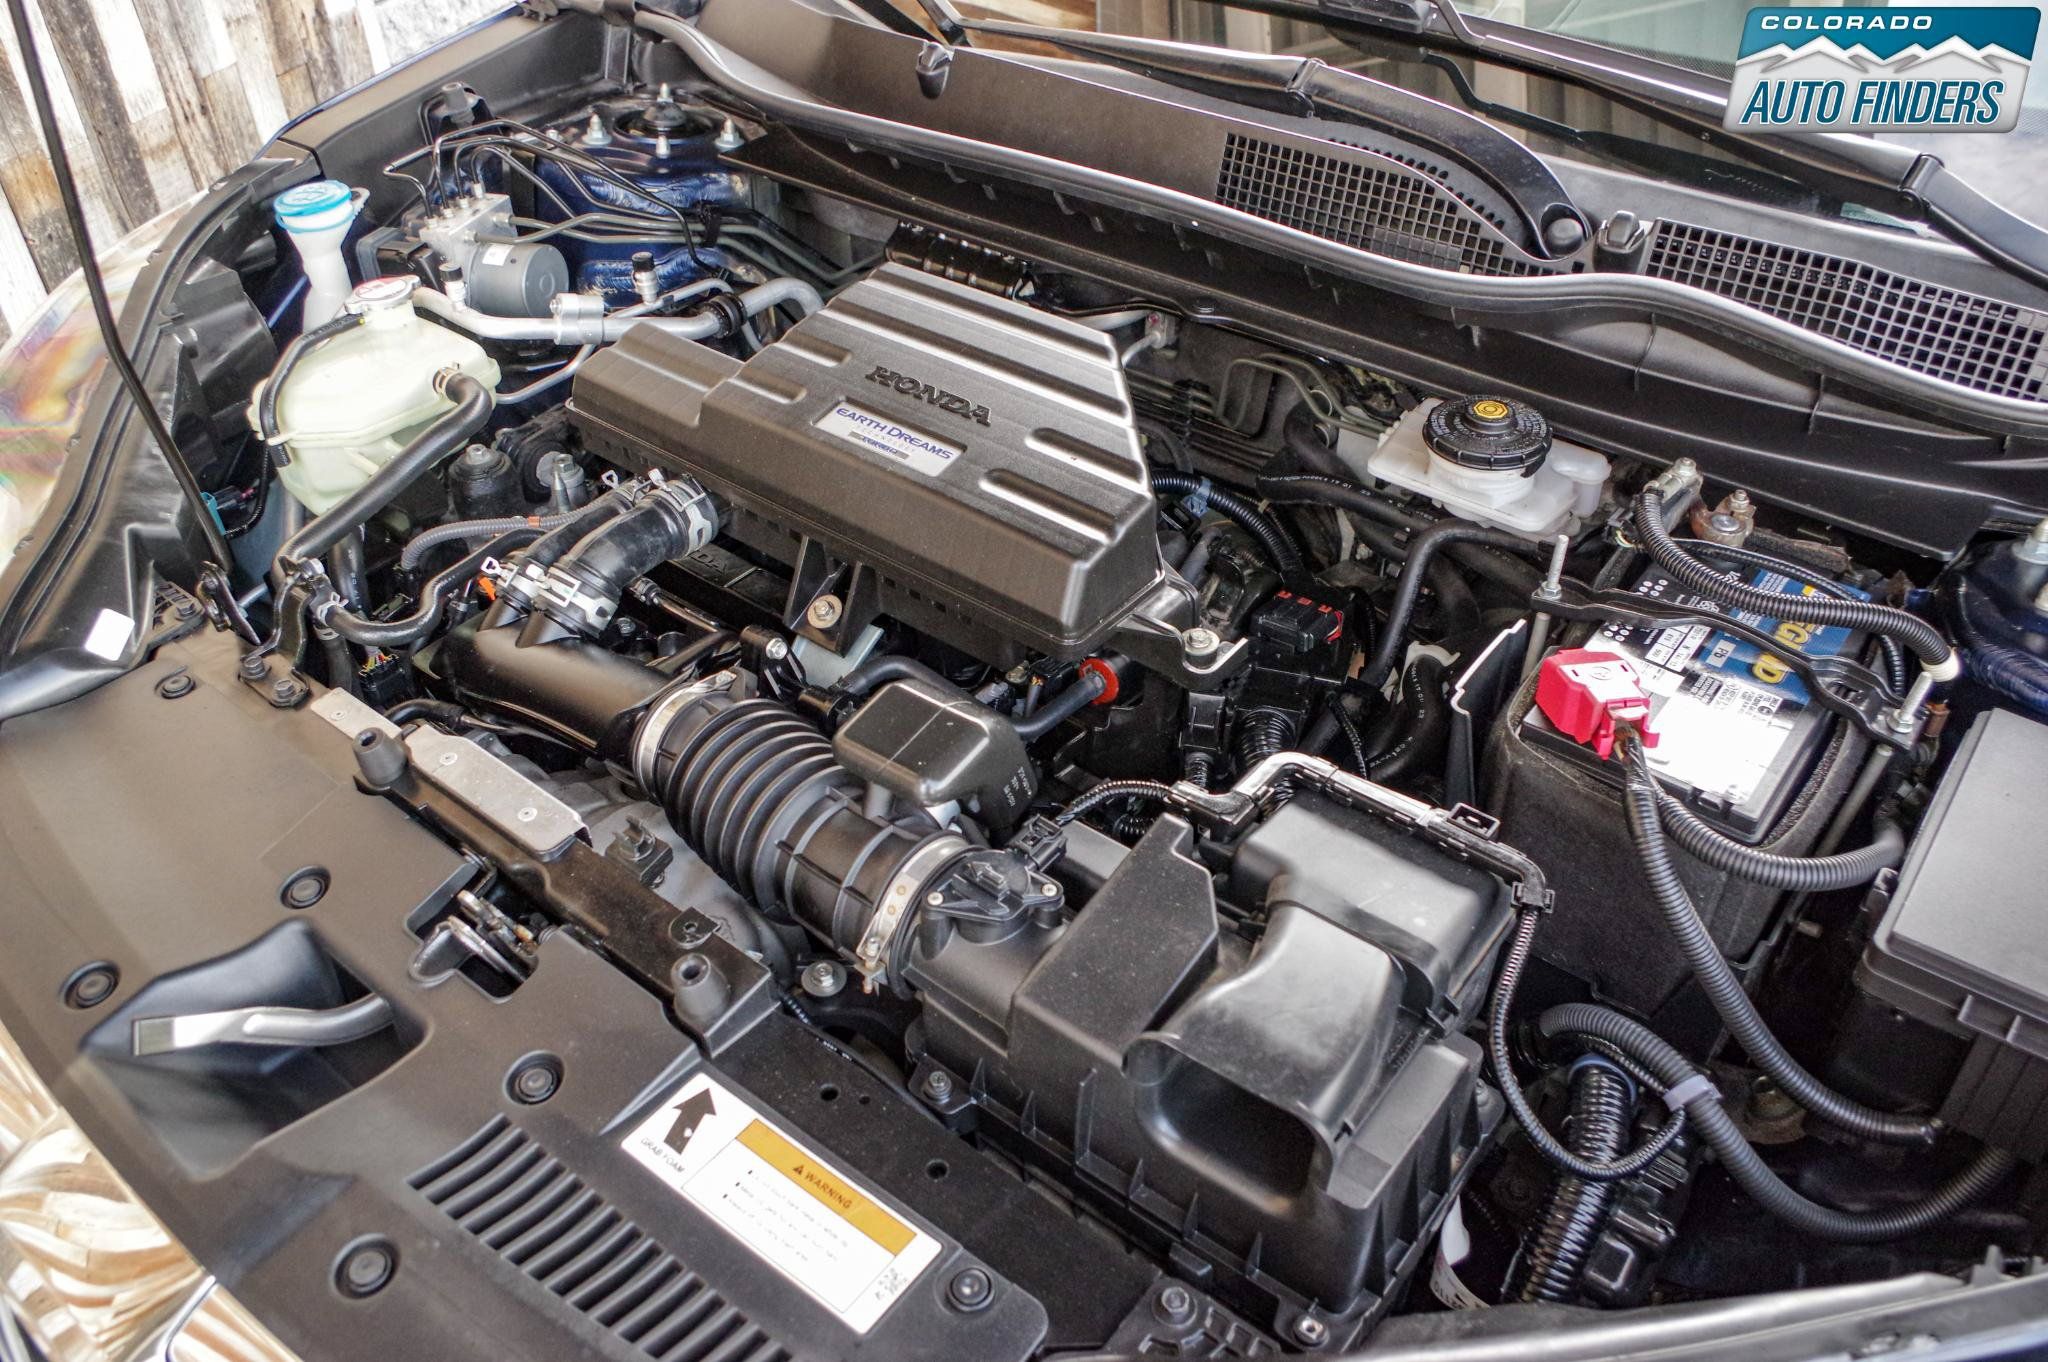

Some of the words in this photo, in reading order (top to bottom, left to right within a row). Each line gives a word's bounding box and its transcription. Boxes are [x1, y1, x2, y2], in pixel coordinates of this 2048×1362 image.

[865, 365, 991, 426] HONDA
[836, 407, 888, 432] EARTH
[887, 426, 953, 460] DREAMS
[804, 1171, 853, 1210] WARNING
